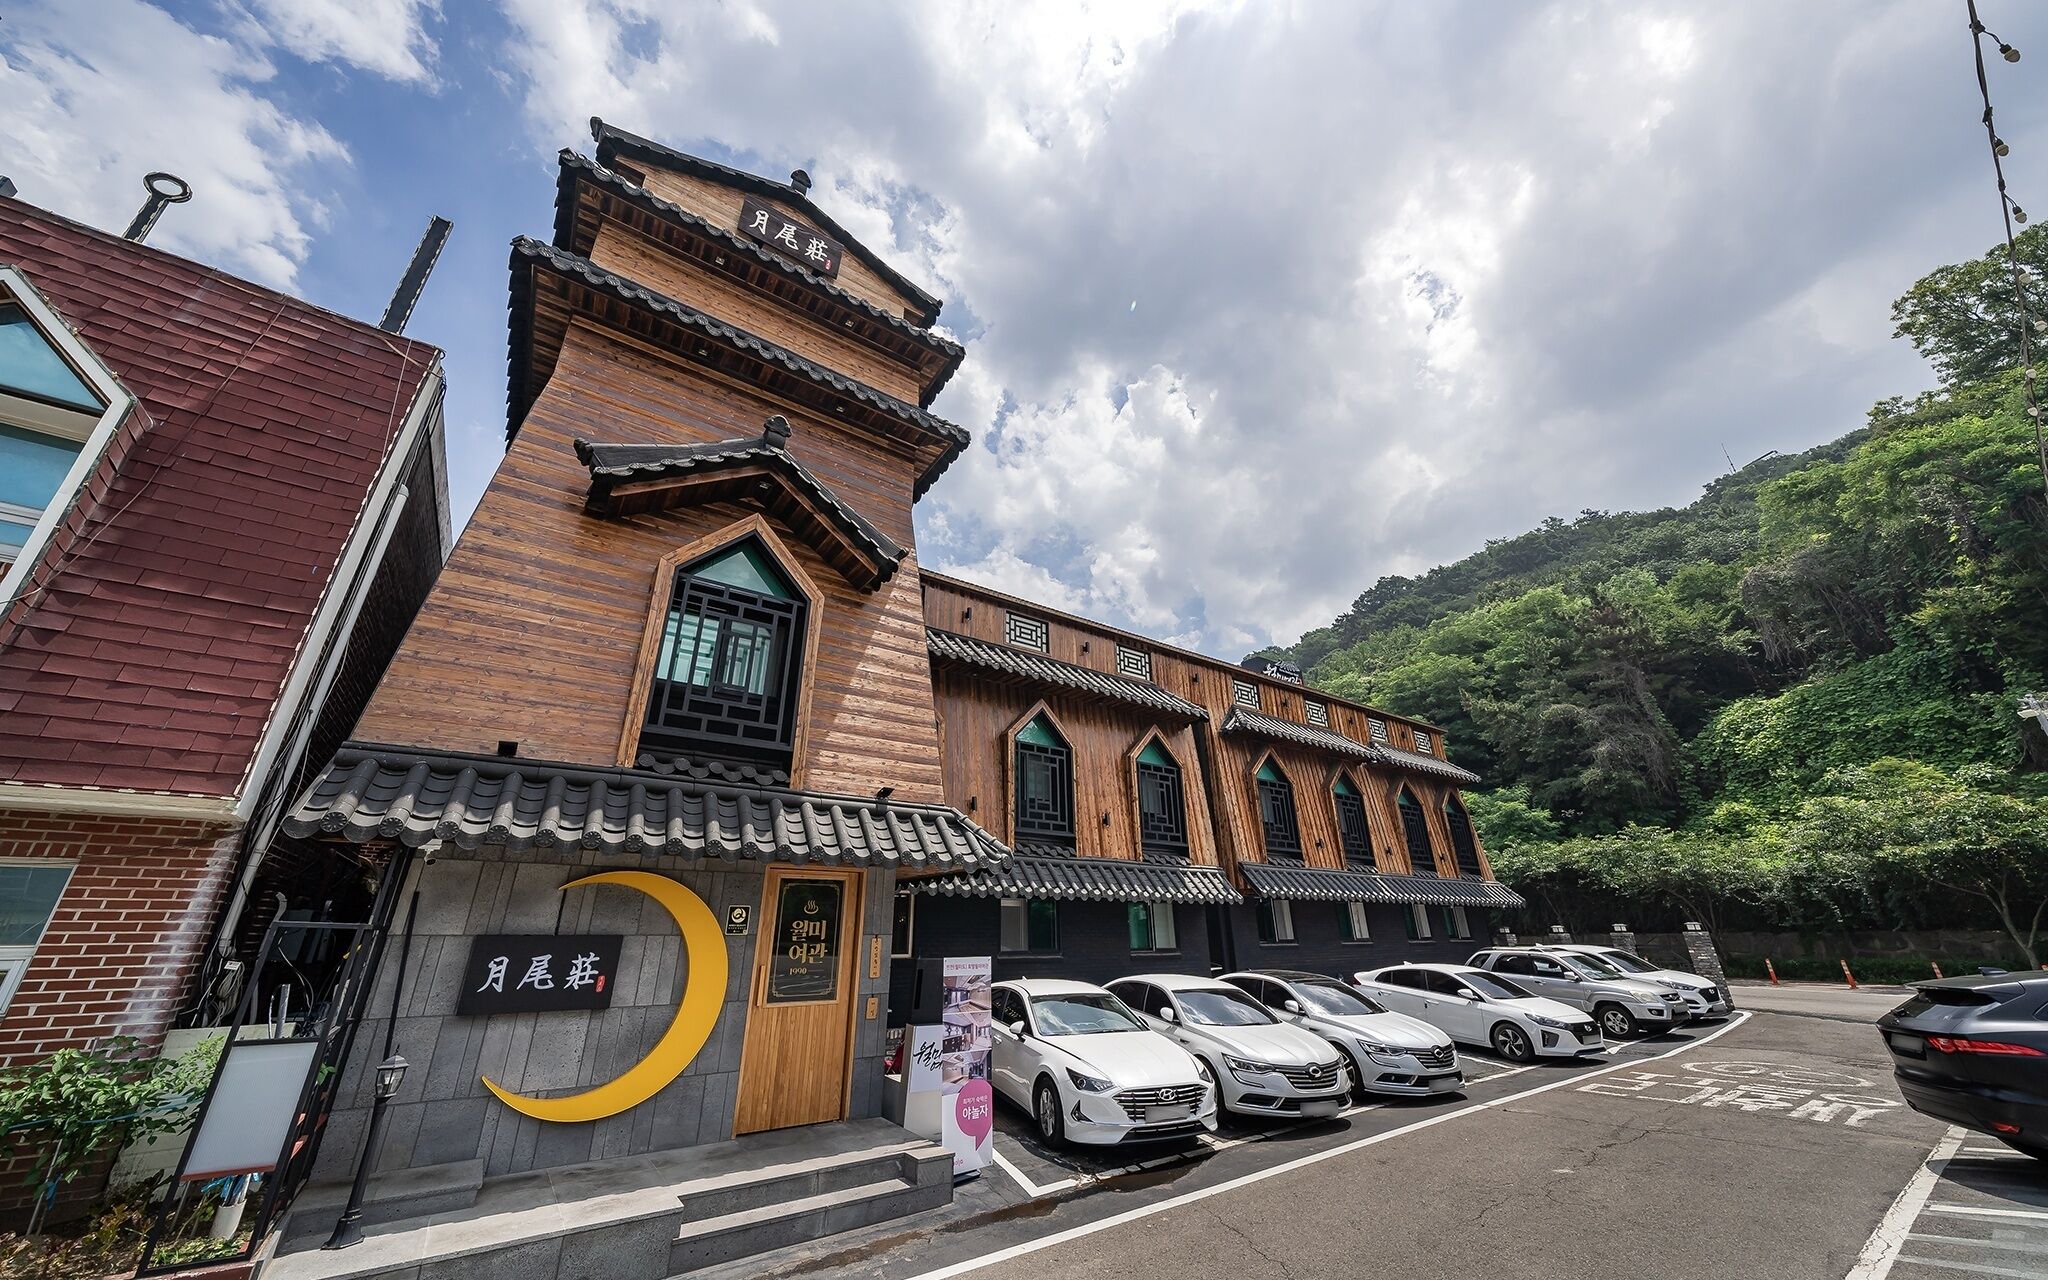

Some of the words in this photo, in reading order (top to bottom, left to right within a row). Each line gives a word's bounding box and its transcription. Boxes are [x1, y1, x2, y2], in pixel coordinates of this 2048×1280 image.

[750, 210, 829, 262] 月尾莊
[790, 920, 827, 942] 월미
[788, 942, 828, 964] 여관
[476, 951, 600, 993] 月尾莊
[962, 1103, 989, 1120] 야놀자
